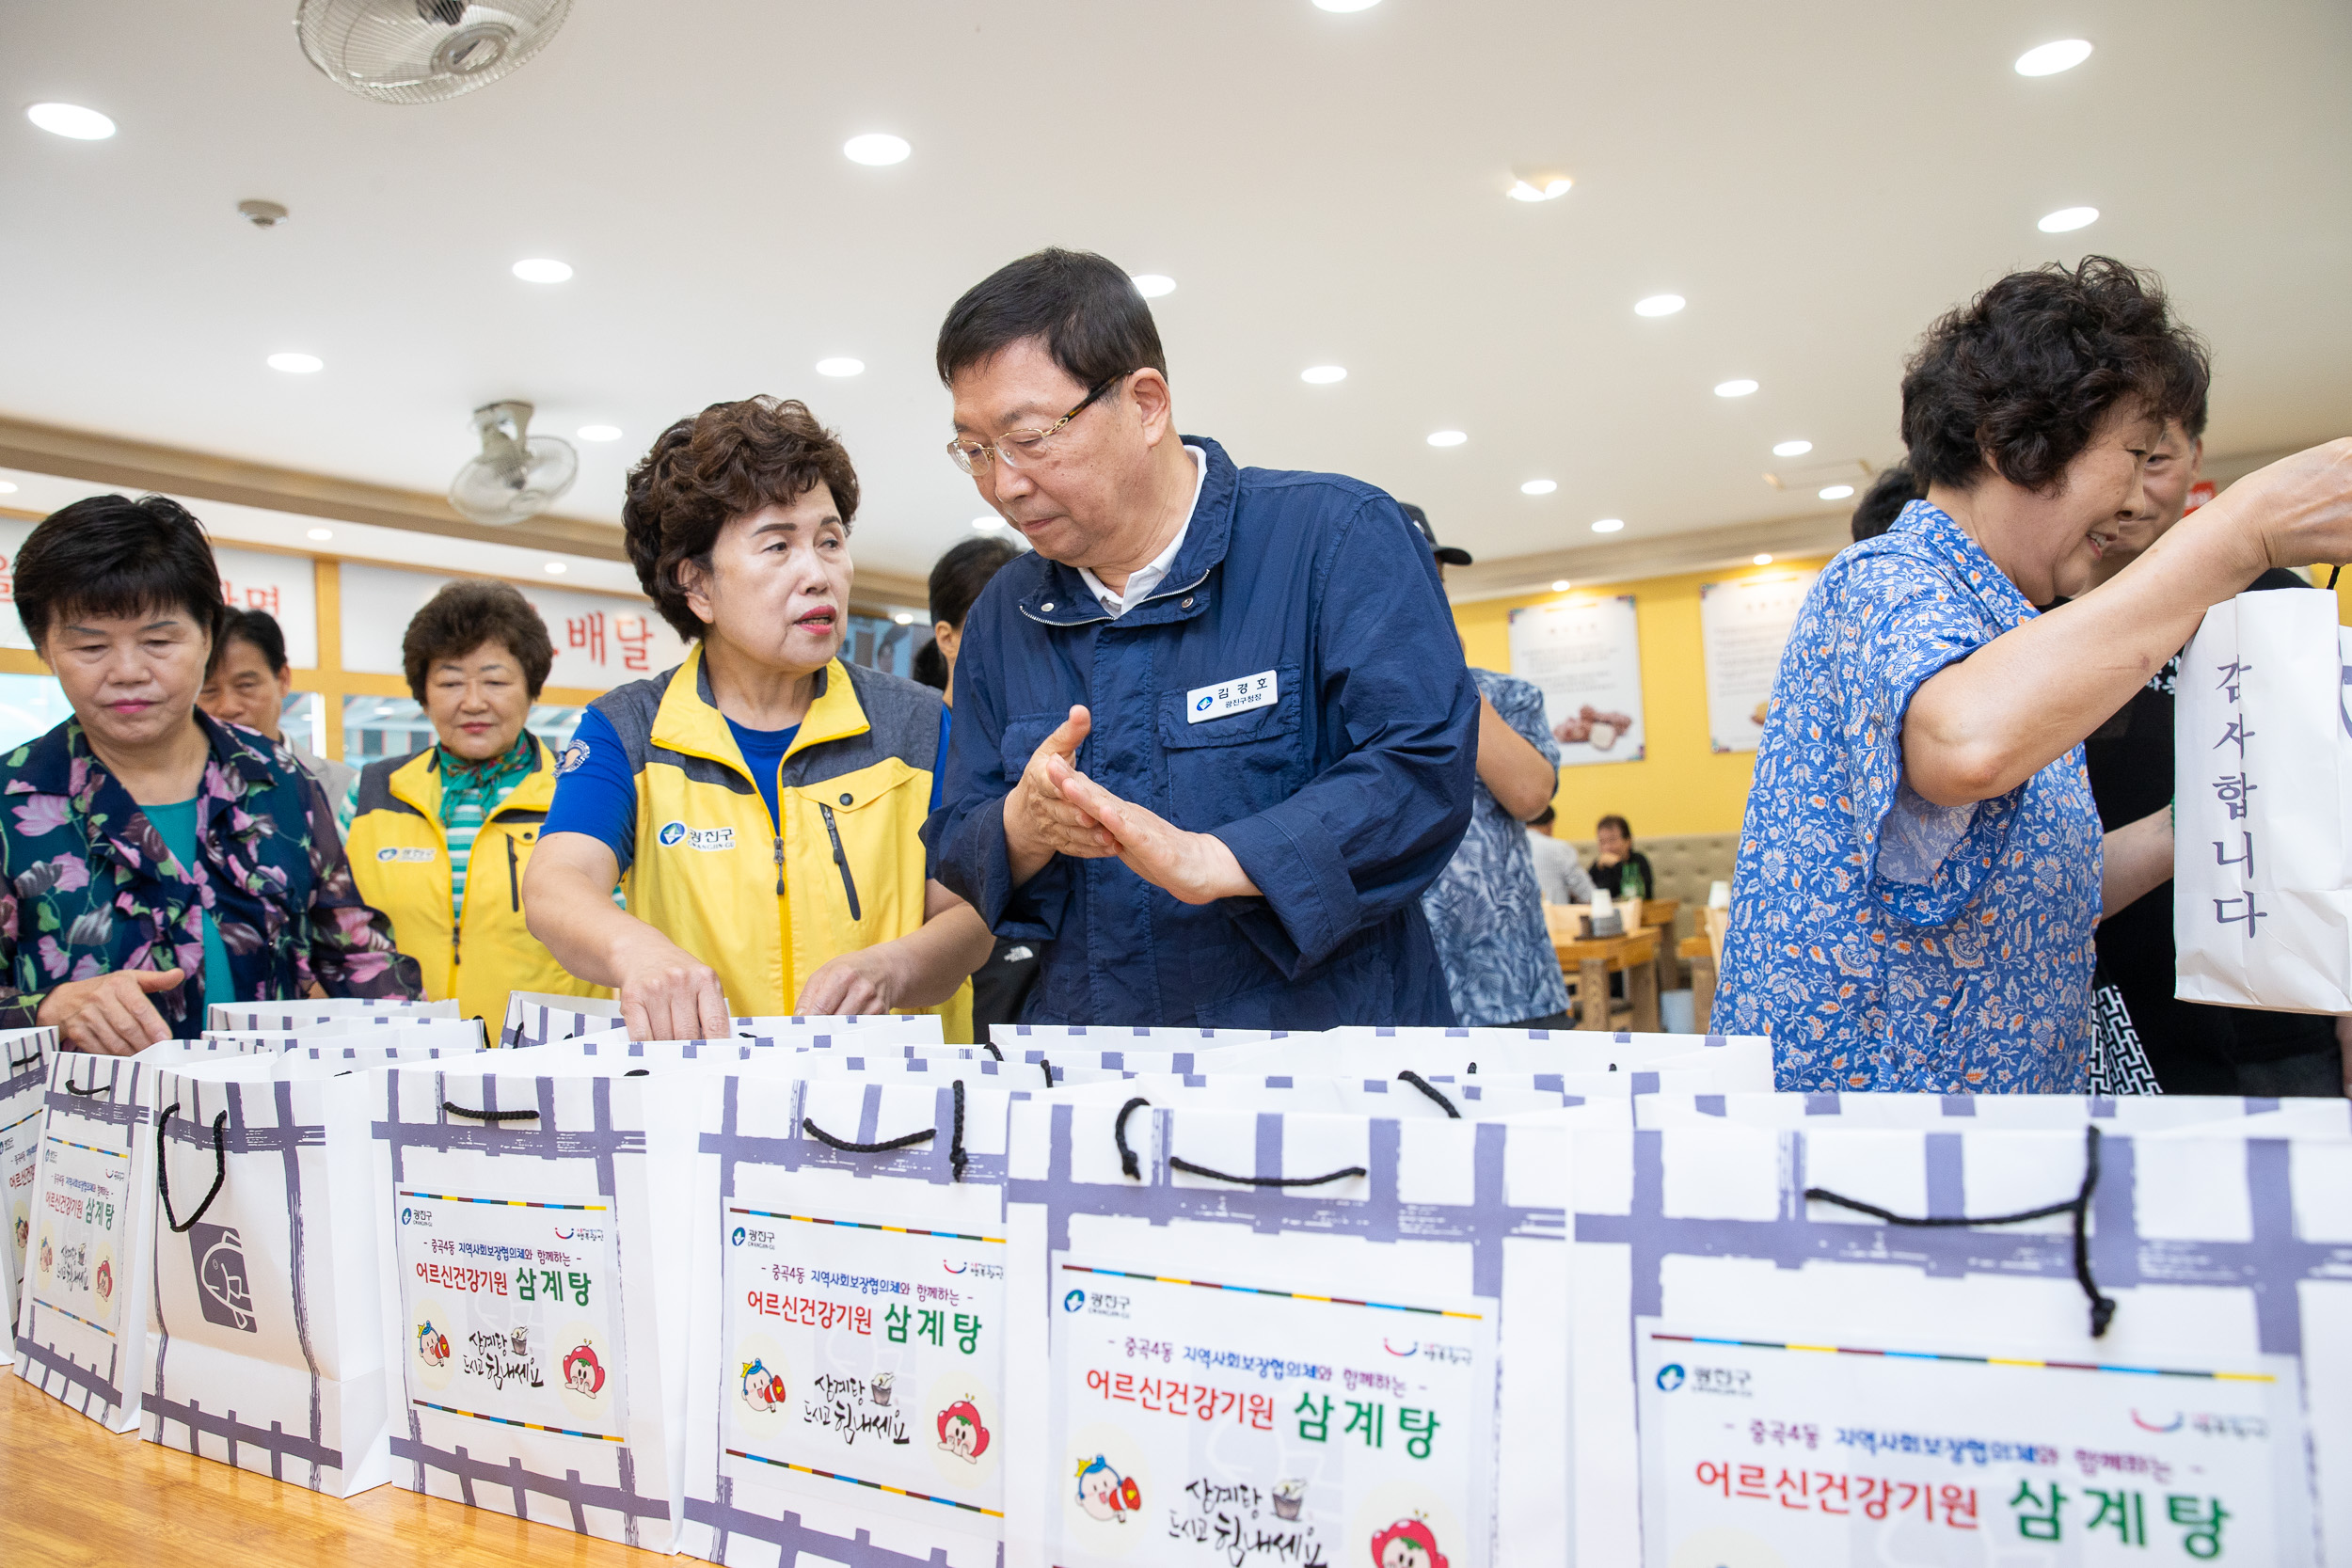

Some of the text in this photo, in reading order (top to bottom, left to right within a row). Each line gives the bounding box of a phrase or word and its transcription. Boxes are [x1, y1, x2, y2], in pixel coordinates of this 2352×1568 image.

[566, 610, 655, 671] 배달
[1217, 677, 1268, 700] 김경호
[1225, 693, 1262, 708] 광진구청장
[2212, 654, 2267, 939] 감사합니다
[689, 829, 733, 843] 광진구
[86, 1196, 115, 1231] 삼계탕
[413, 1209, 433, 1221] 광진구
[748, 1228, 775, 1243] 광진구
[431, 1239, 571, 1267] 중곡4동 지역사회보장협의체와 함께하는
[416, 1262, 592, 1307] 어르신건강기원 삼계탕
[771, 1263, 961, 1307] 중곡4동 지역사회보장협의체와 함께하는
[747, 1290, 983, 1355] 어르신건강기원 삼계탕
[485, 1354, 545, 1391] 힘내세요
[1123, 1336, 1407, 1399] 중곡4동 지역사회보장협의체와 함께하는
[834, 1400, 911, 1446] 힘내세요
[1086, 1369, 1441, 1460] 어르신건강기원 삼계탕
[1695, 1460, 2233, 1561] 어르신건강기원 삼계탕
